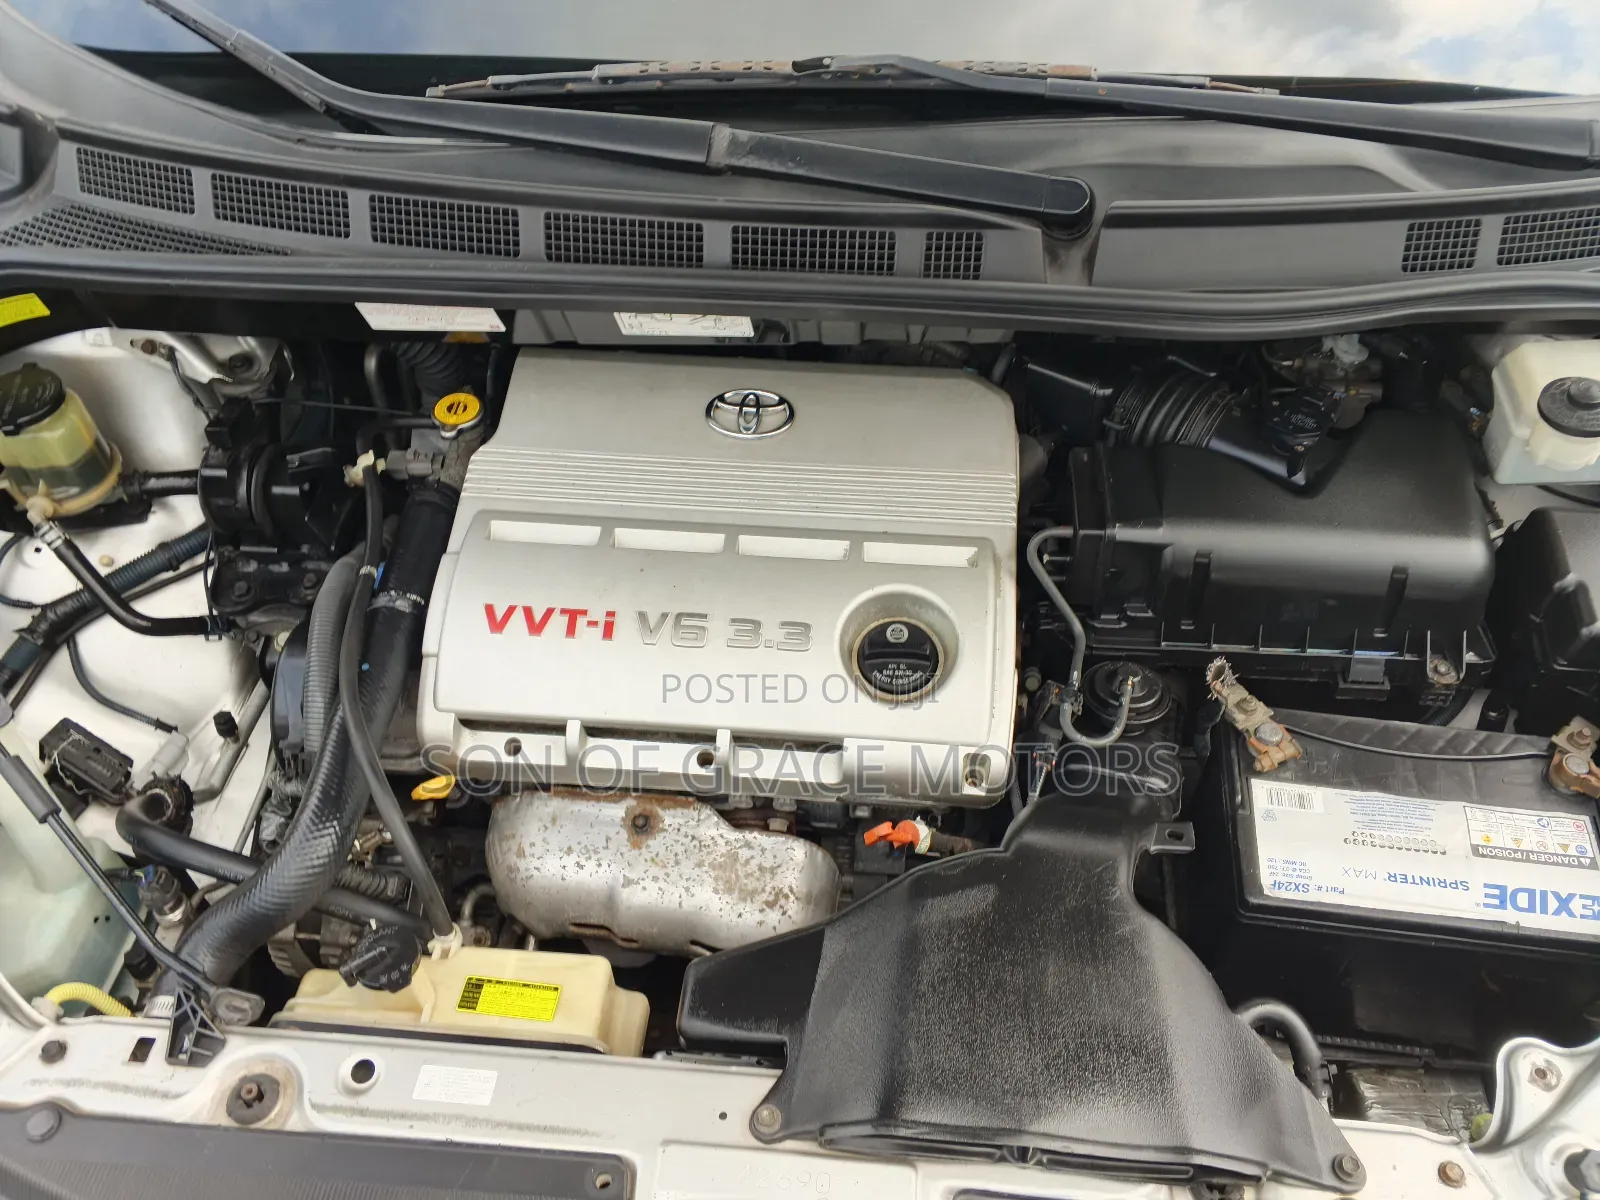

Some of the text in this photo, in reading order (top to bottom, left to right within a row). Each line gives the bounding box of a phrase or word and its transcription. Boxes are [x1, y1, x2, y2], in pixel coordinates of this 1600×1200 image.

[483, 602, 814, 652] VVT-i V6 3.3
[1478, 846, 1521, 858] POISON
[1528, 852, 1578, 866] DANGER
[1341, 866, 1377, 880] MAX
[1268, 879, 1310, 894] SX24F
[1325, 884, 1345, 895] Part
